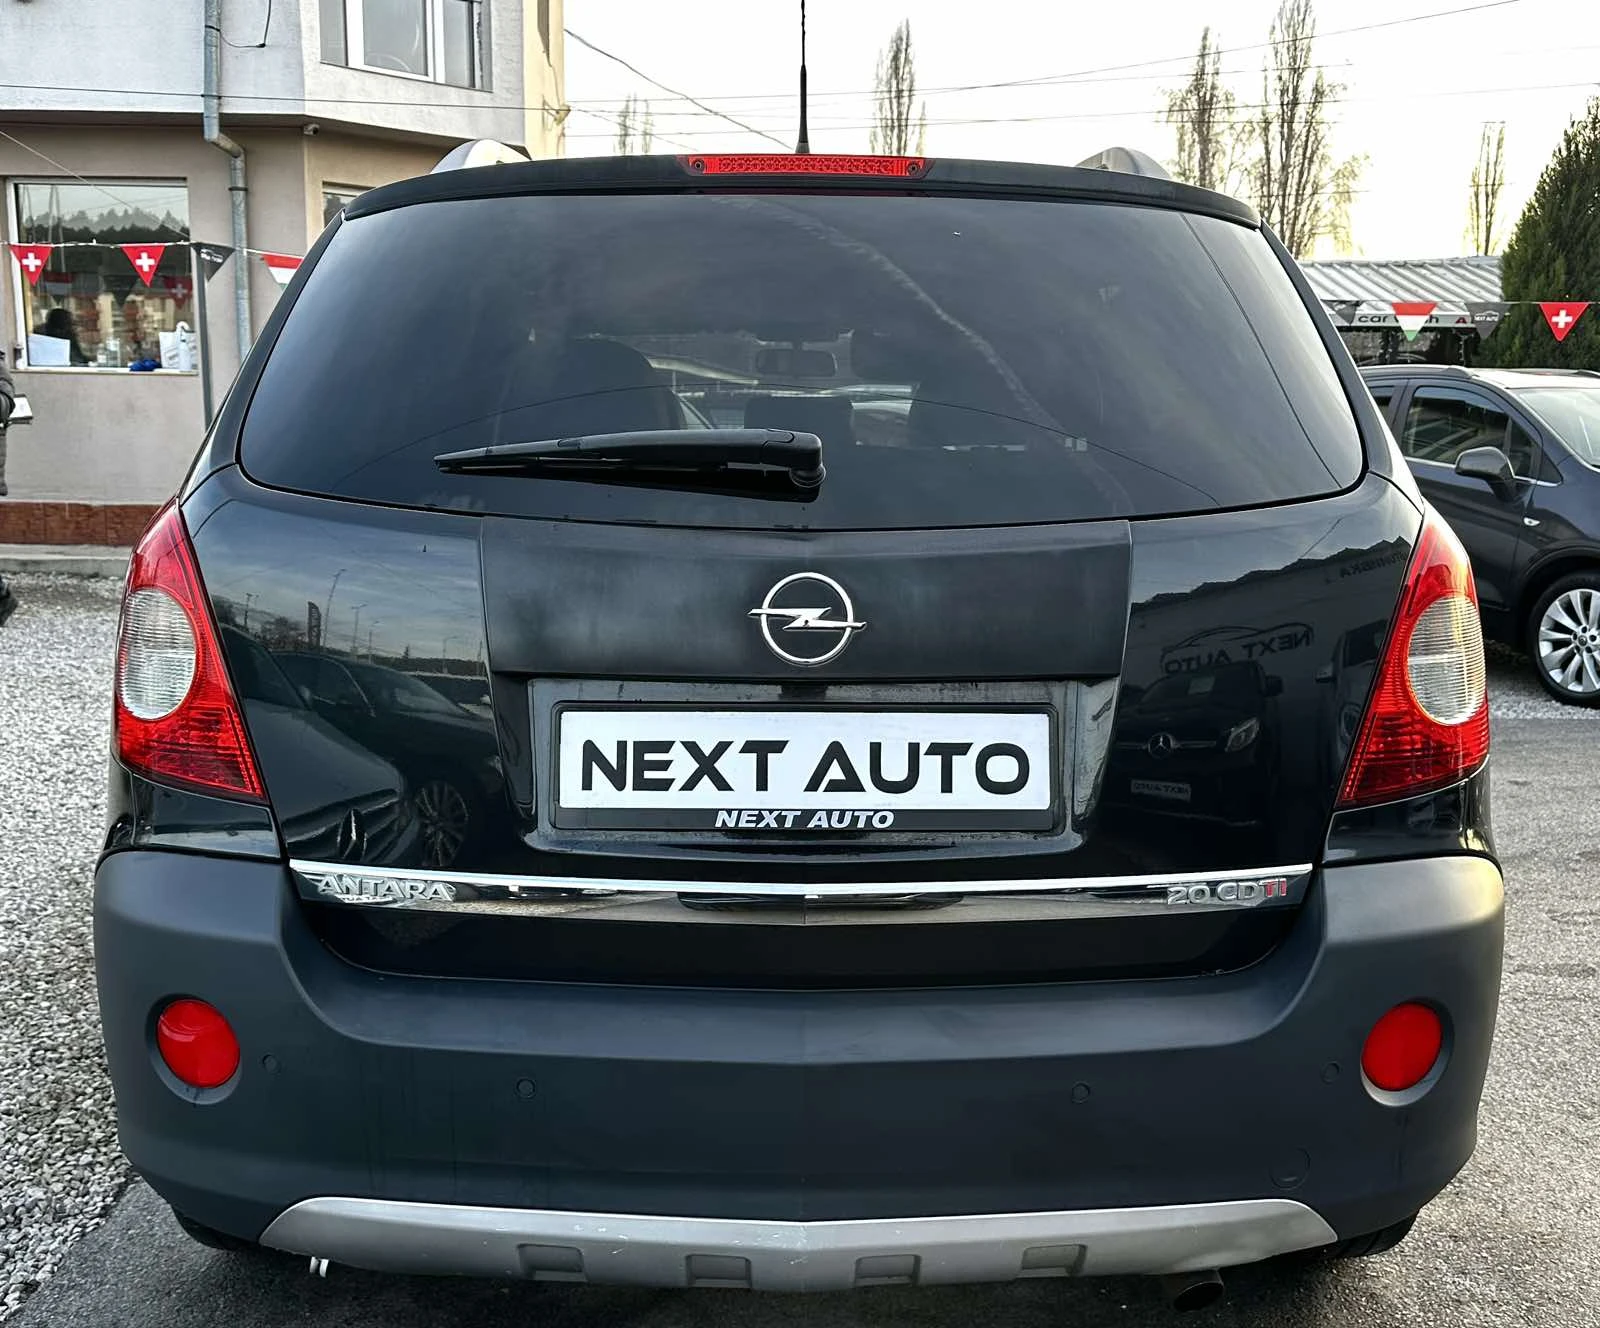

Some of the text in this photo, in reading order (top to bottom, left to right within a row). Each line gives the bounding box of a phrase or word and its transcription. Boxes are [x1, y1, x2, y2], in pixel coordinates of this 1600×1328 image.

[1358, 315, 1388, 323] car
[581, 739, 1031, 794] NEXT AUTO
[714, 809, 895, 829] NEXT AUTO
[318, 874, 454, 901] ANTARA
[1217, 878, 1288, 902] CDTI
